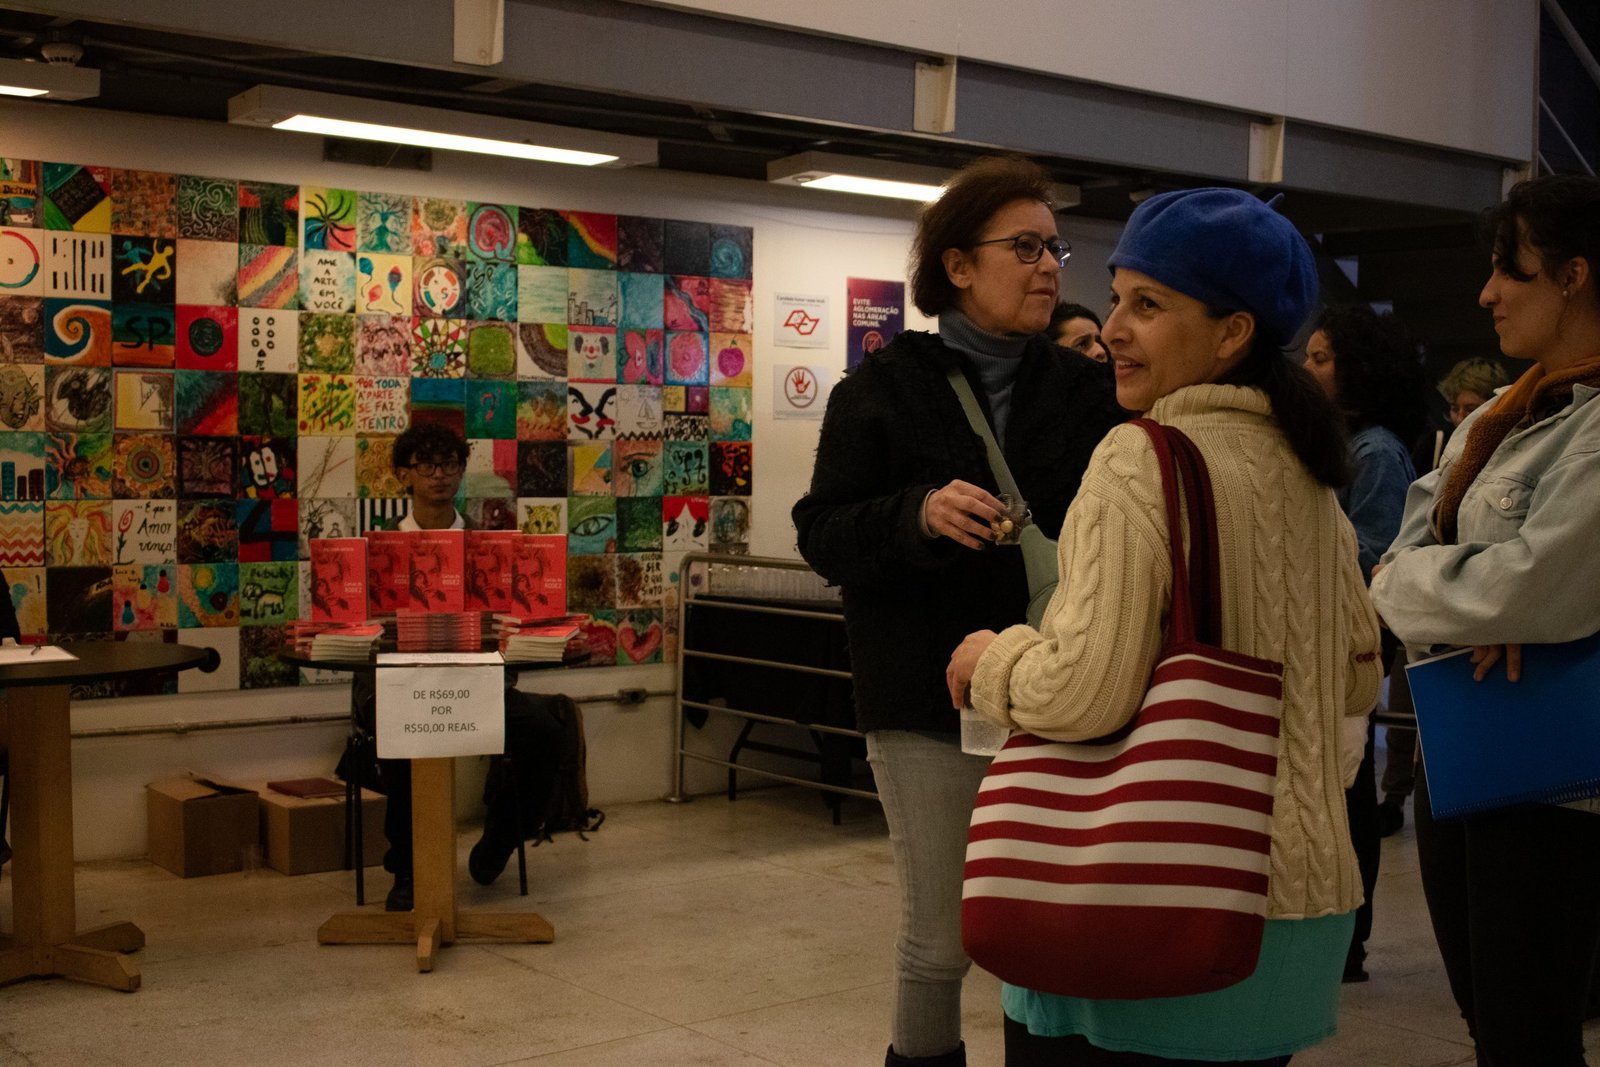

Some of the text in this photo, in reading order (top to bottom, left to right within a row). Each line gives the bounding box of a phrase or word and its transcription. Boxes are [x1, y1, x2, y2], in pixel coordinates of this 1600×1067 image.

[317, 258, 337, 266] AME
[313, 277, 338, 286] ARTE
[319, 290, 335, 299] EM
[314, 297, 344, 309] VOCÊ
[853, 305, 899, 315] AGLOMERAÇÃO
[121, 315, 171, 351] SP
[358, 378, 400, 389] POR TODA
[366, 390, 394, 399] PARTE
[358, 401, 395, 413] SE FAZ
[360, 416, 406, 429] TEATRO
[137, 517, 172, 537] Amor
[645, 562, 660, 572] SER
[644, 574, 649, 583] O
[413, 688, 470, 701] DE R$69,00
[431, 706, 452, 715] POR
[404, 722, 479, 734] R$50,00 REAIS.
